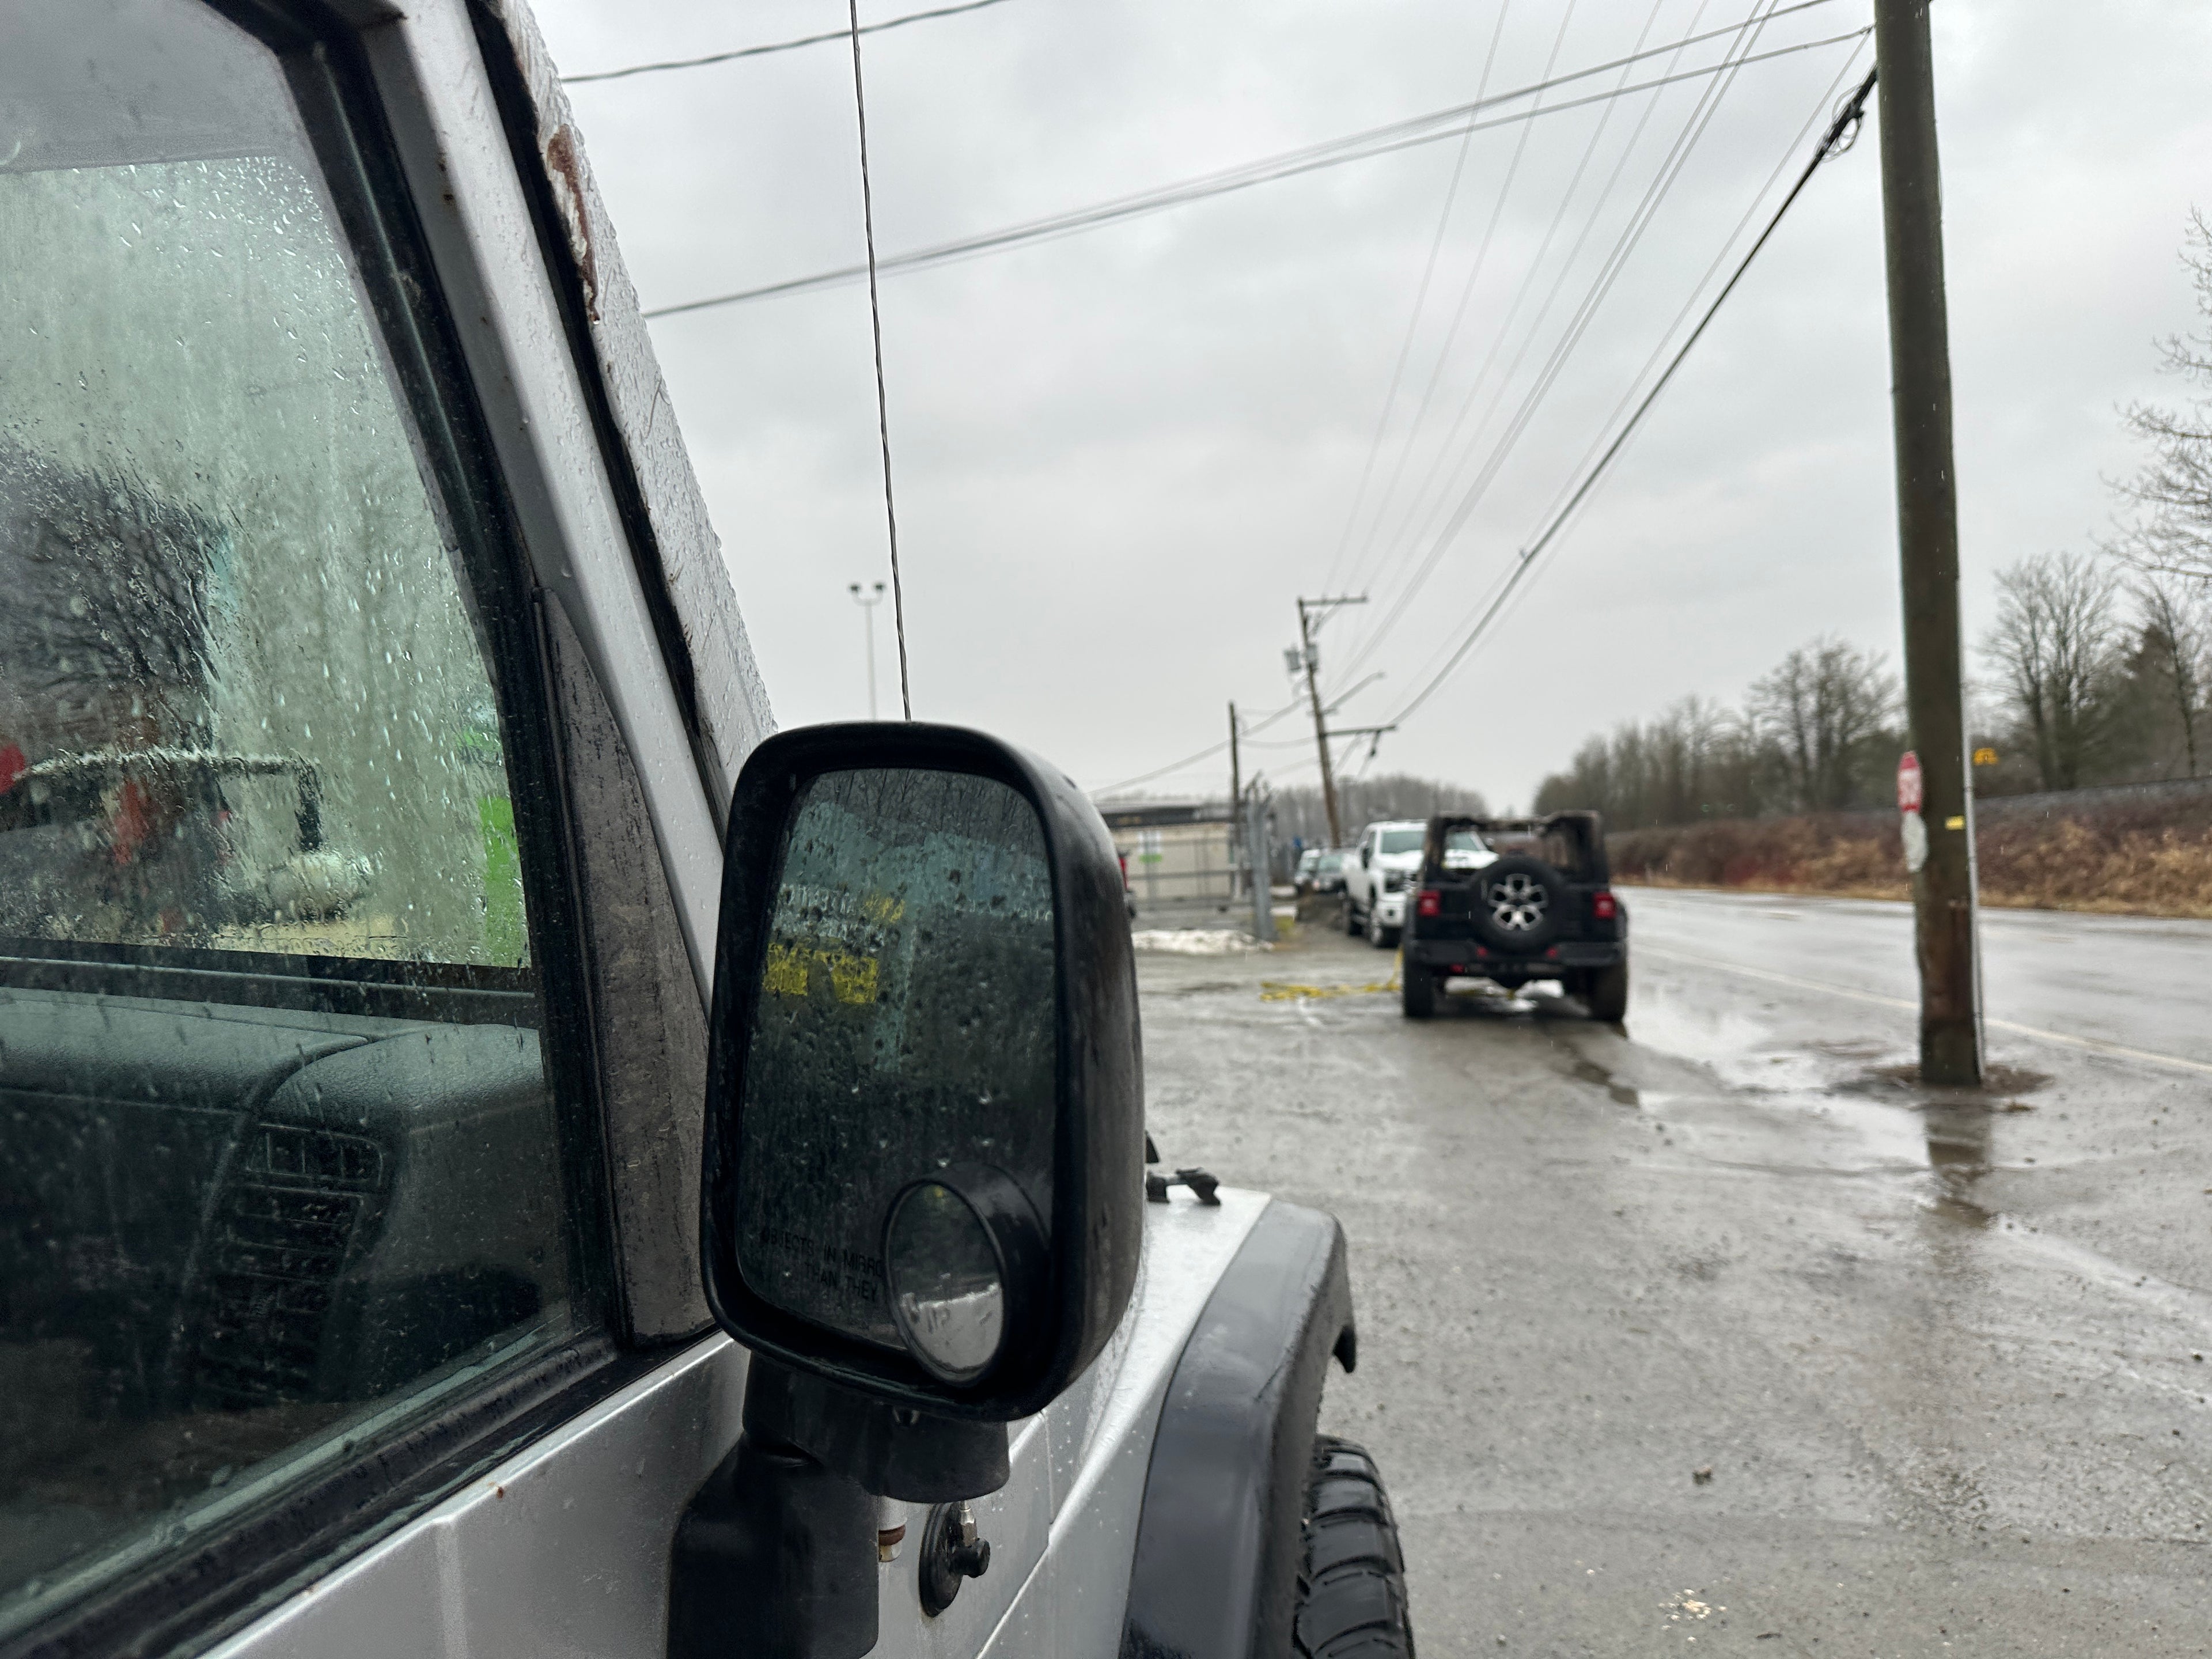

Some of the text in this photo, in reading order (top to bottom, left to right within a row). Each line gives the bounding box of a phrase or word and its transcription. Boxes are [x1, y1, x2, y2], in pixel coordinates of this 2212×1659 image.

[760, 1228, 882, 1277] OBJECTS IN MIRRO
[805, 1262, 877, 1301] THAN THEY
